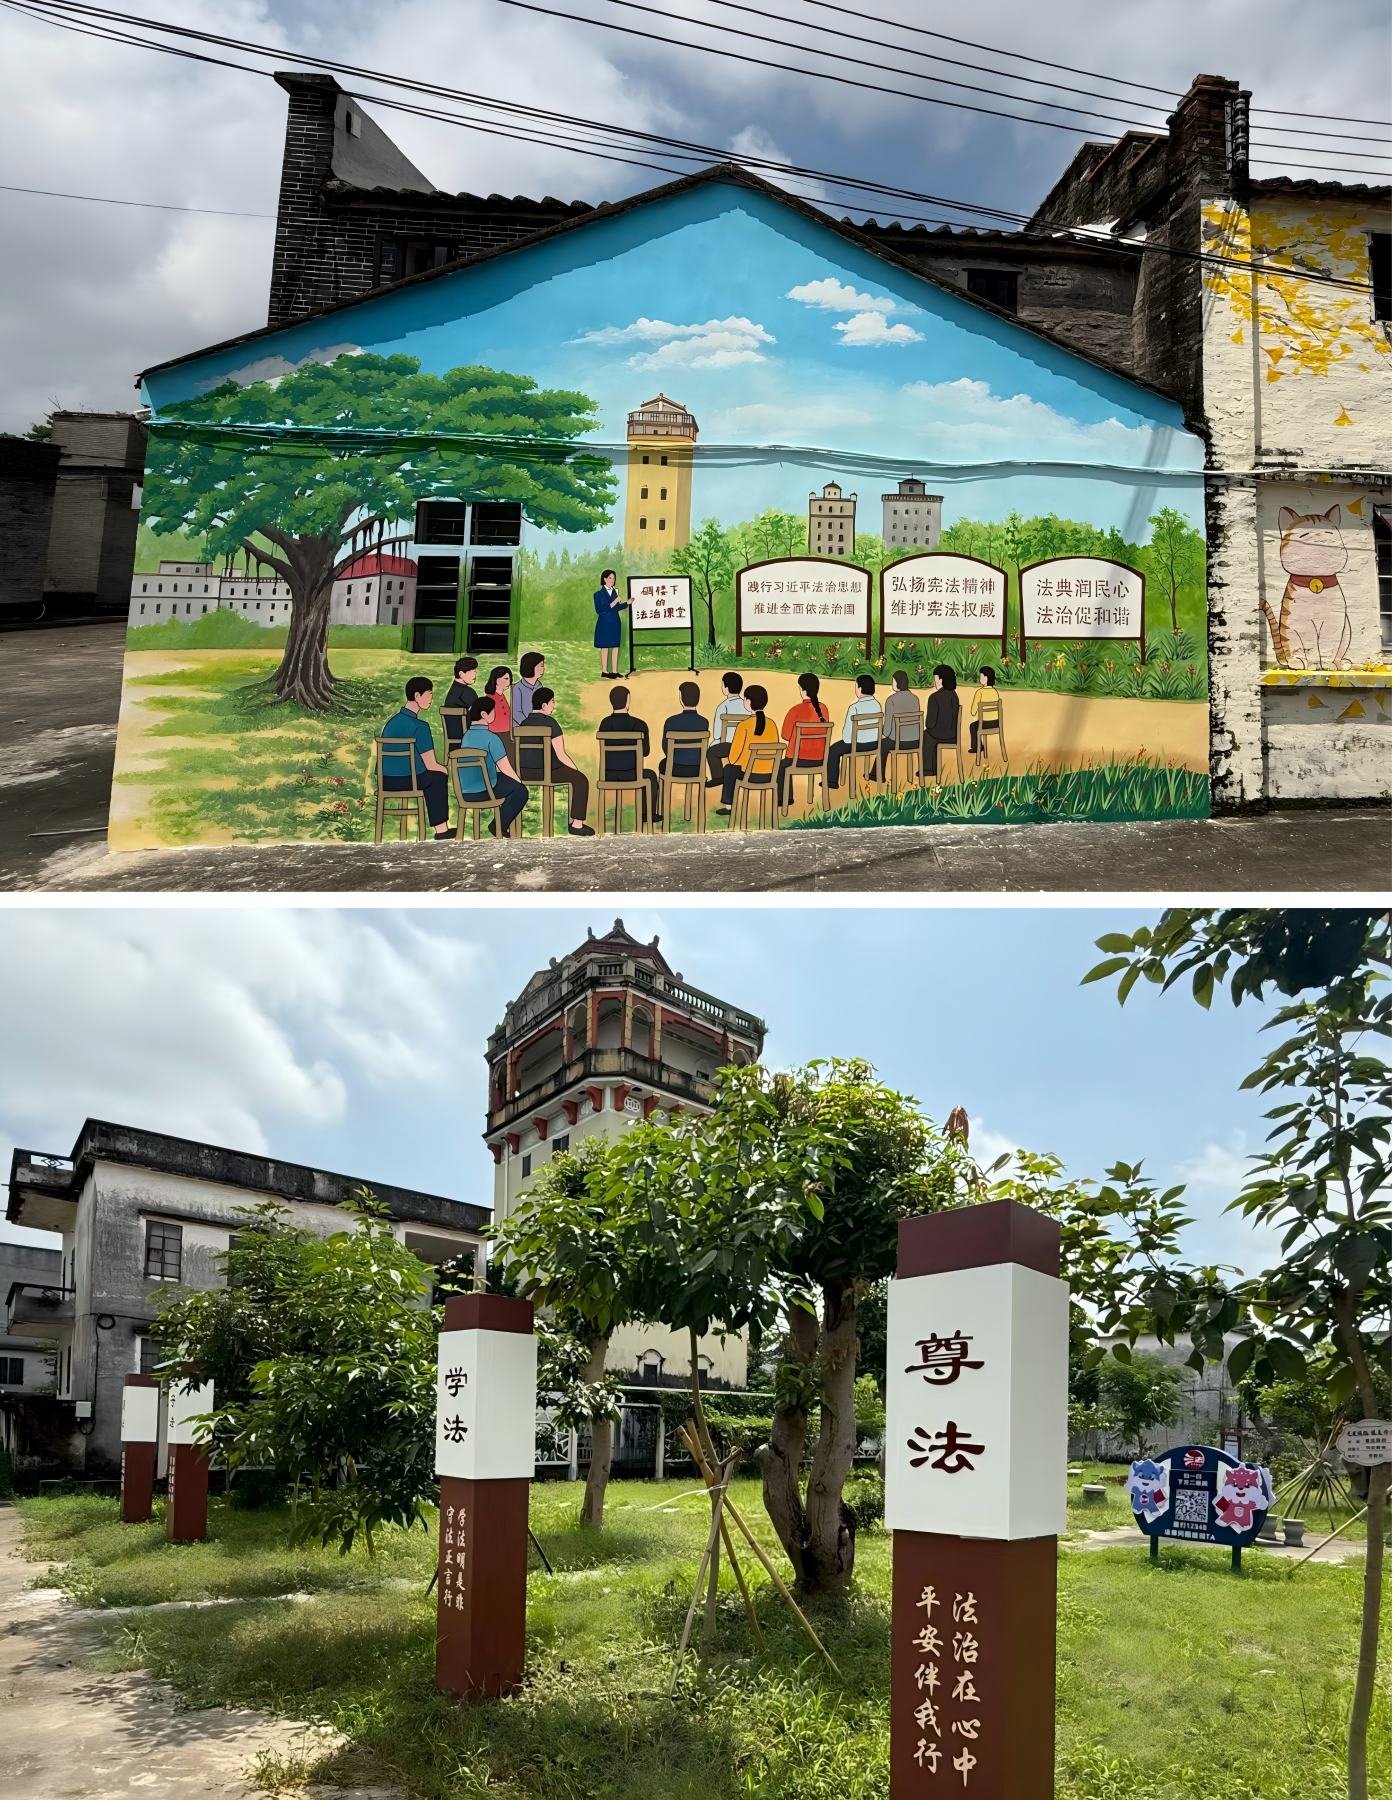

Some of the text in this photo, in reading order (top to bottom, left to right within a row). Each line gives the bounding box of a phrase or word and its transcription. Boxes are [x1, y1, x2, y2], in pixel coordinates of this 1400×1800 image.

[641, 585, 678, 596] 碉楼下
[747, 580, 862, 594] 践行习近平法治思想
[891, 575, 996, 595] 弘扬宪法精神
[1036, 578, 1130, 598] 法典润民心
[655, 598, 666, 606] 的
[753, 602, 856, 616] 推进全面依法治国
[890, 599, 996, 618] 维护宪法权威
[636, 607, 686, 620] 法治课堂
[1036, 605, 1130, 627] 法治促和谐
[443, 1366, 468, 1444] 学法
[904, 1329, 986, 1474] 尊法
[912, 1585, 944, 1775] 平安伴我行
[951, 1592, 982, 1788] 法治在心中
